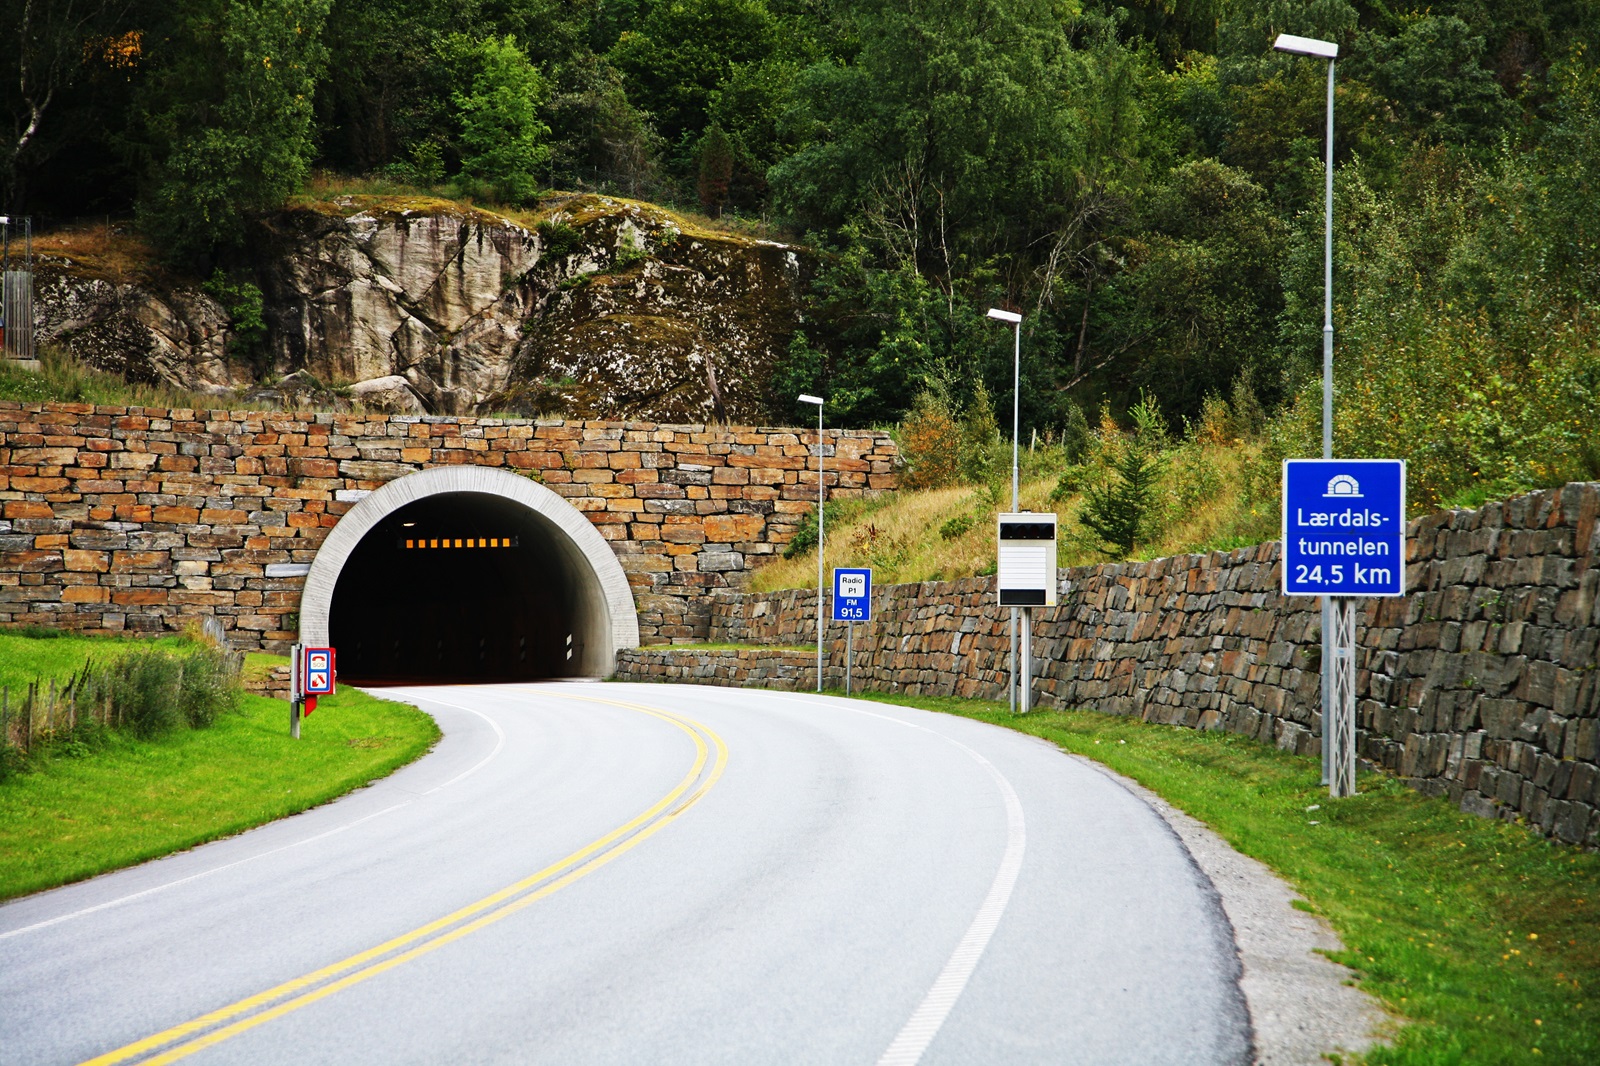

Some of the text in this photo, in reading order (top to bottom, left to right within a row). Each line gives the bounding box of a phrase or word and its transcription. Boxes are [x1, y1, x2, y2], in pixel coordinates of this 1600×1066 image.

[1297, 508, 1390, 527] Lærdals-
[1298, 537, 1389, 556] tunnelen
[1295, 562, 1391, 586] 24,5 km
[841, 607, 863, 619] 91,5
